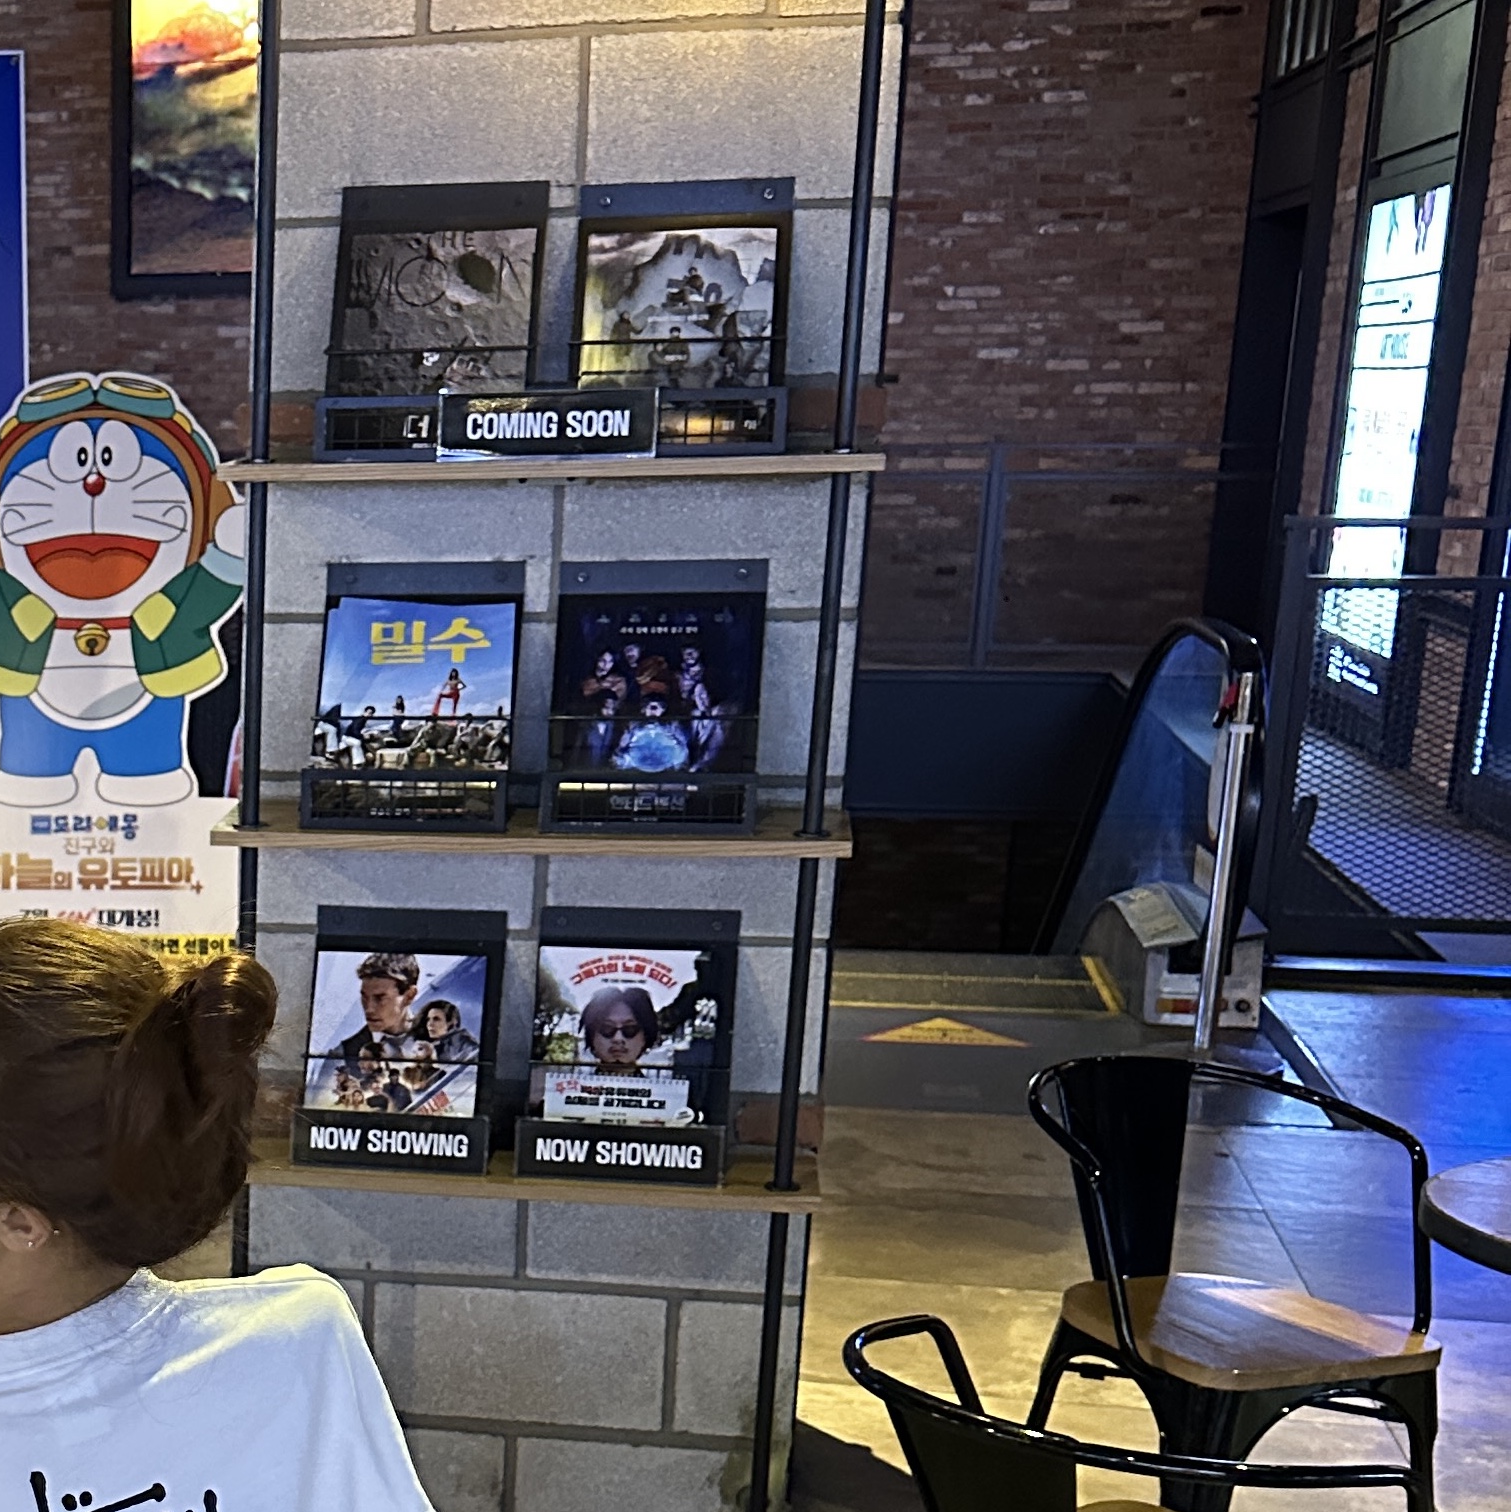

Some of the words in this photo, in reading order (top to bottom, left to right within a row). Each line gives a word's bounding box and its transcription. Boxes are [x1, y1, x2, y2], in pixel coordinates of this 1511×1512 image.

[466, 411, 558, 440] COMING
[565, 410, 630, 438] SOON
[370, 616, 491, 665] 밀수
[78, 857, 194, 890] 유토피아
[97, 909, 160, 927] 대개봉!
[184, 937, 224, 956] 선물이
[310, 1125, 361, 1151] NOW
[367, 1129, 469, 1158] SHOWING
[535, 1138, 589, 1164] NOW
[595, 1140, 703, 1170] SHOWING
